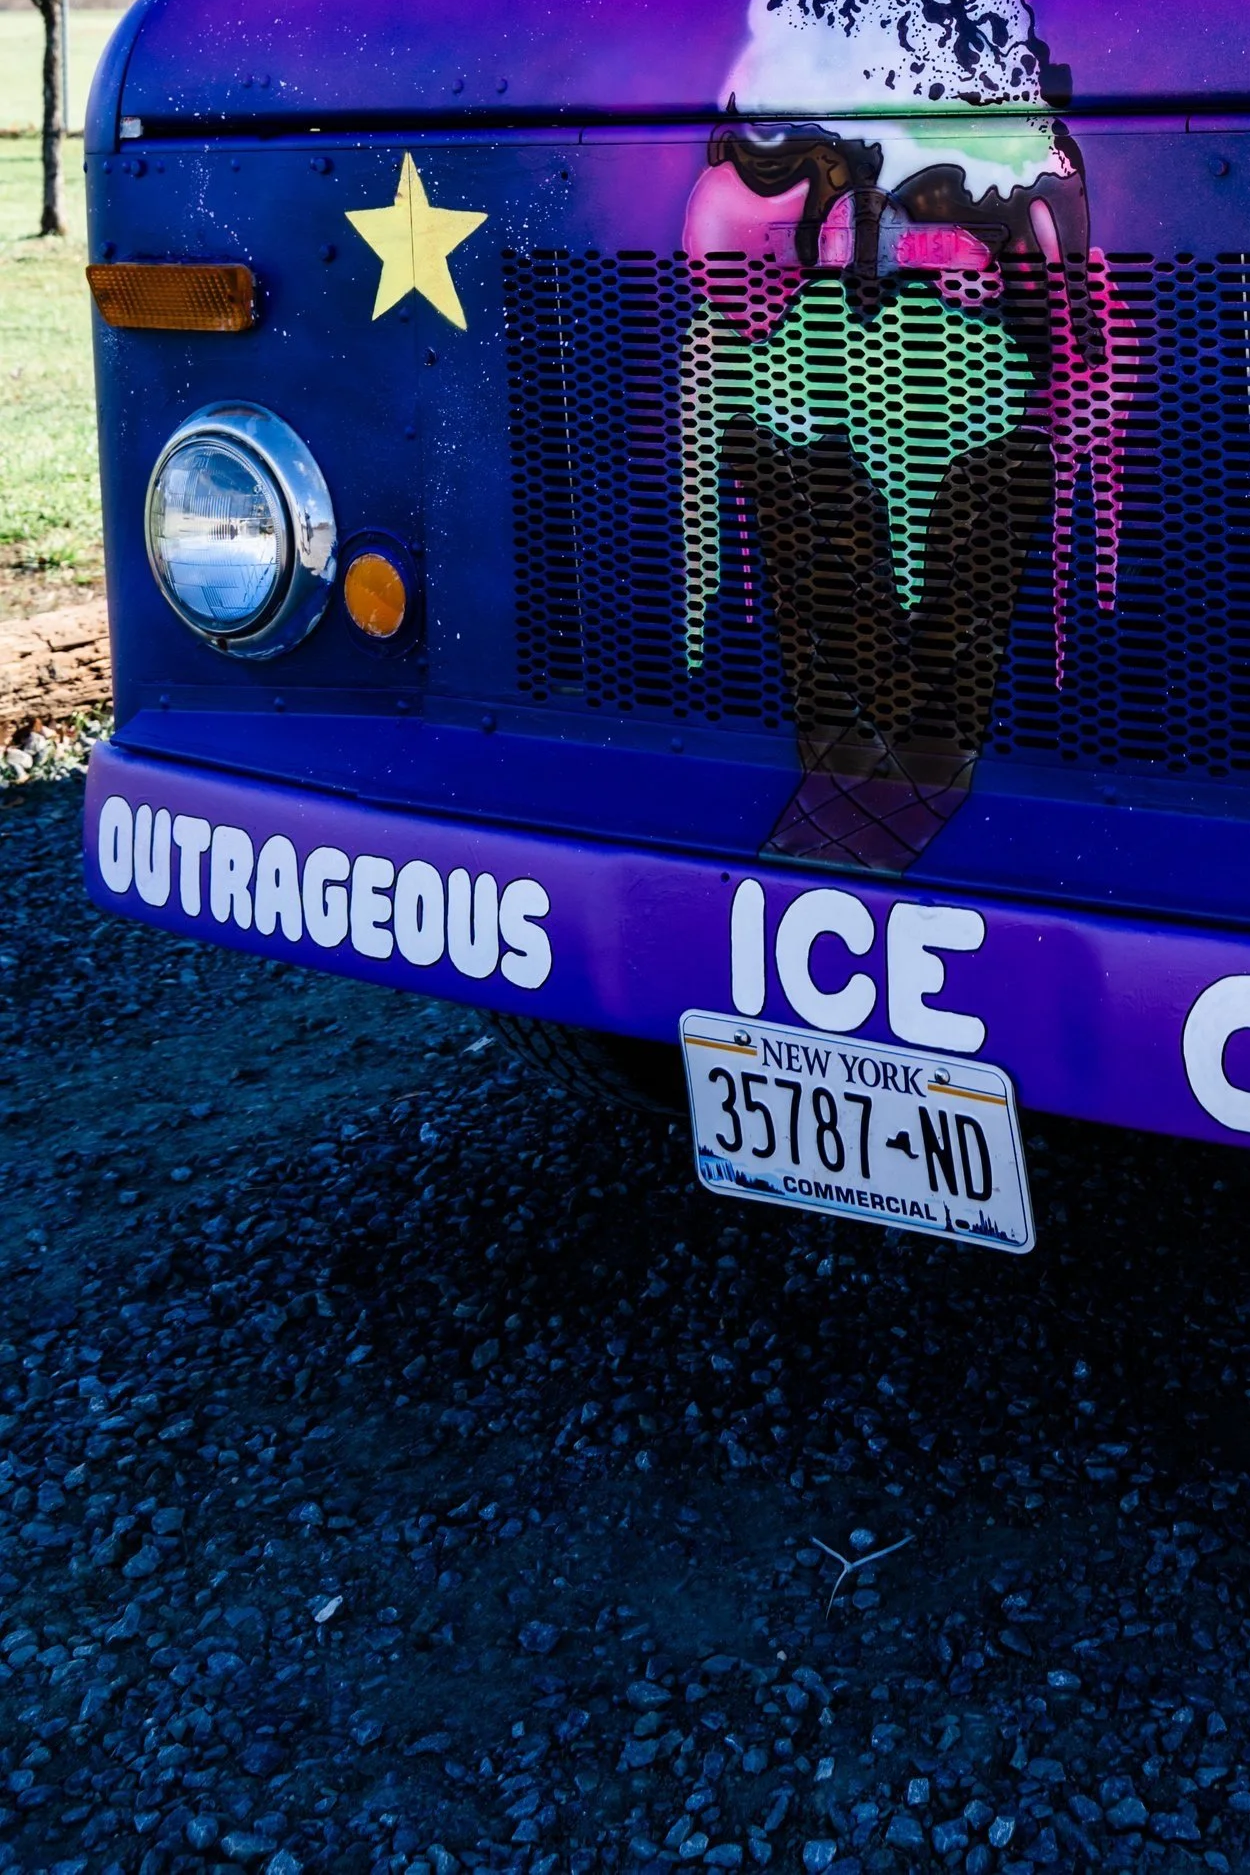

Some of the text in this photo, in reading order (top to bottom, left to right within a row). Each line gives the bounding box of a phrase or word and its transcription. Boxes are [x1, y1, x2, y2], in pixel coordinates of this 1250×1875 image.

[98, 795, 553, 990] OUTRAGEOUS
[730, 877, 986, 1054] ICE
[708, 1066, 993, 1202] 35787 ND
[760, 1037, 927, 1098] NEW YORK
[782, 1175, 938, 1222] COMMERCIAL
